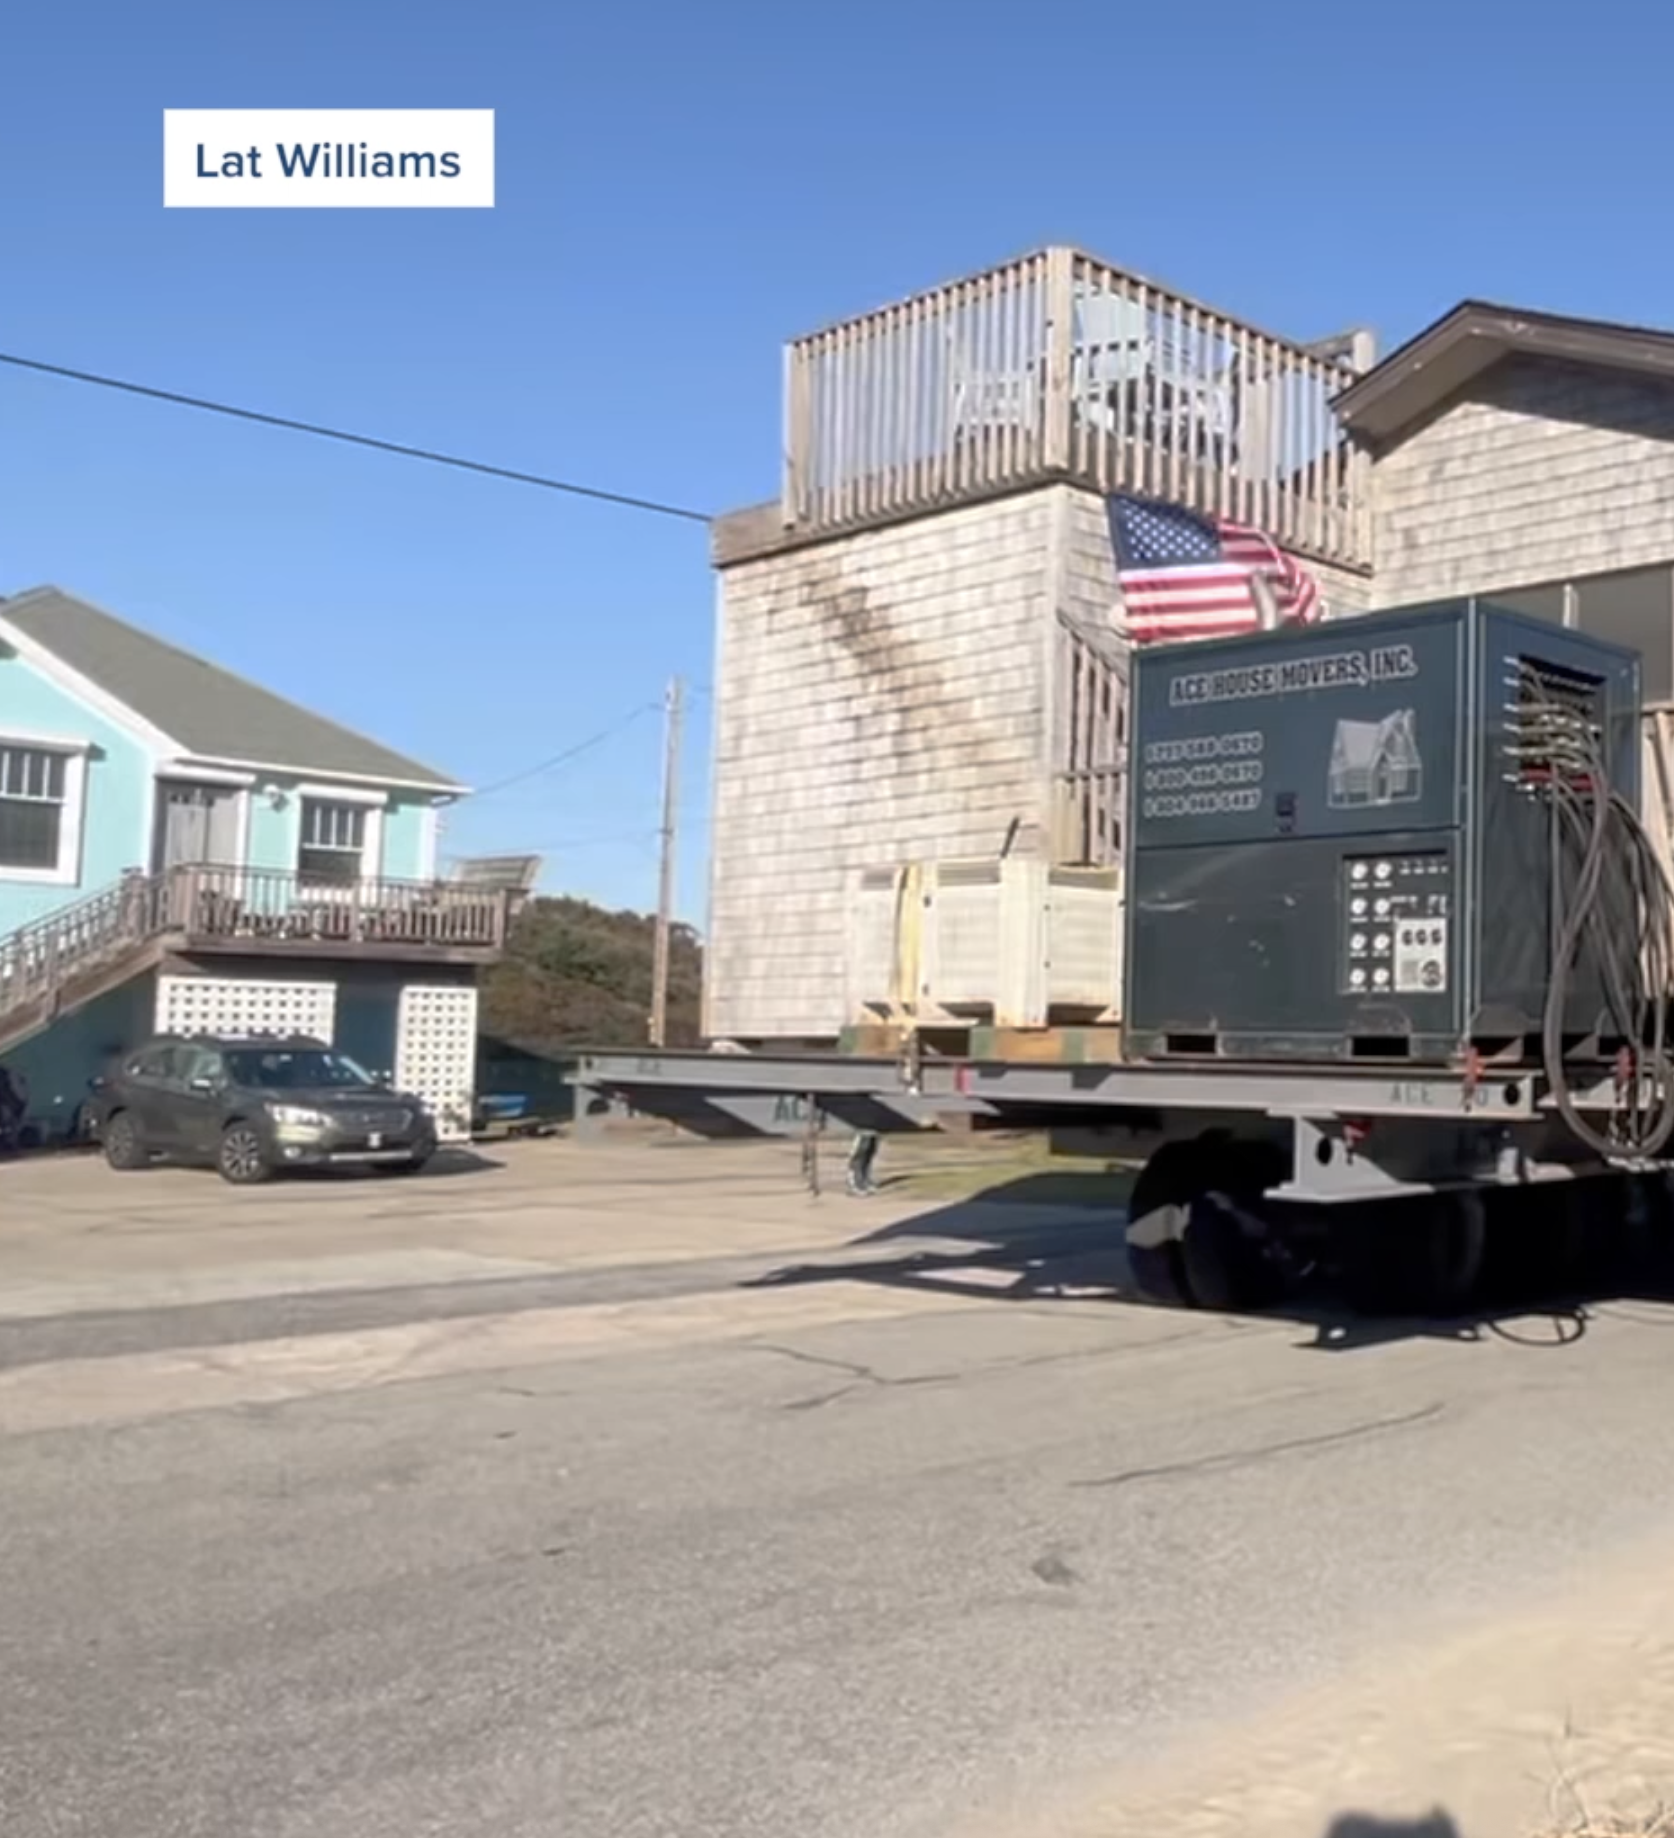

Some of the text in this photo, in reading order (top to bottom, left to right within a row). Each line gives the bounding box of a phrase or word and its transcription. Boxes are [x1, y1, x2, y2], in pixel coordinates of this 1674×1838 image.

[1171, 646, 1417, 704] ACE HOUSE MOVERS, INC.
[1390, 1080, 1434, 1106] ACE
